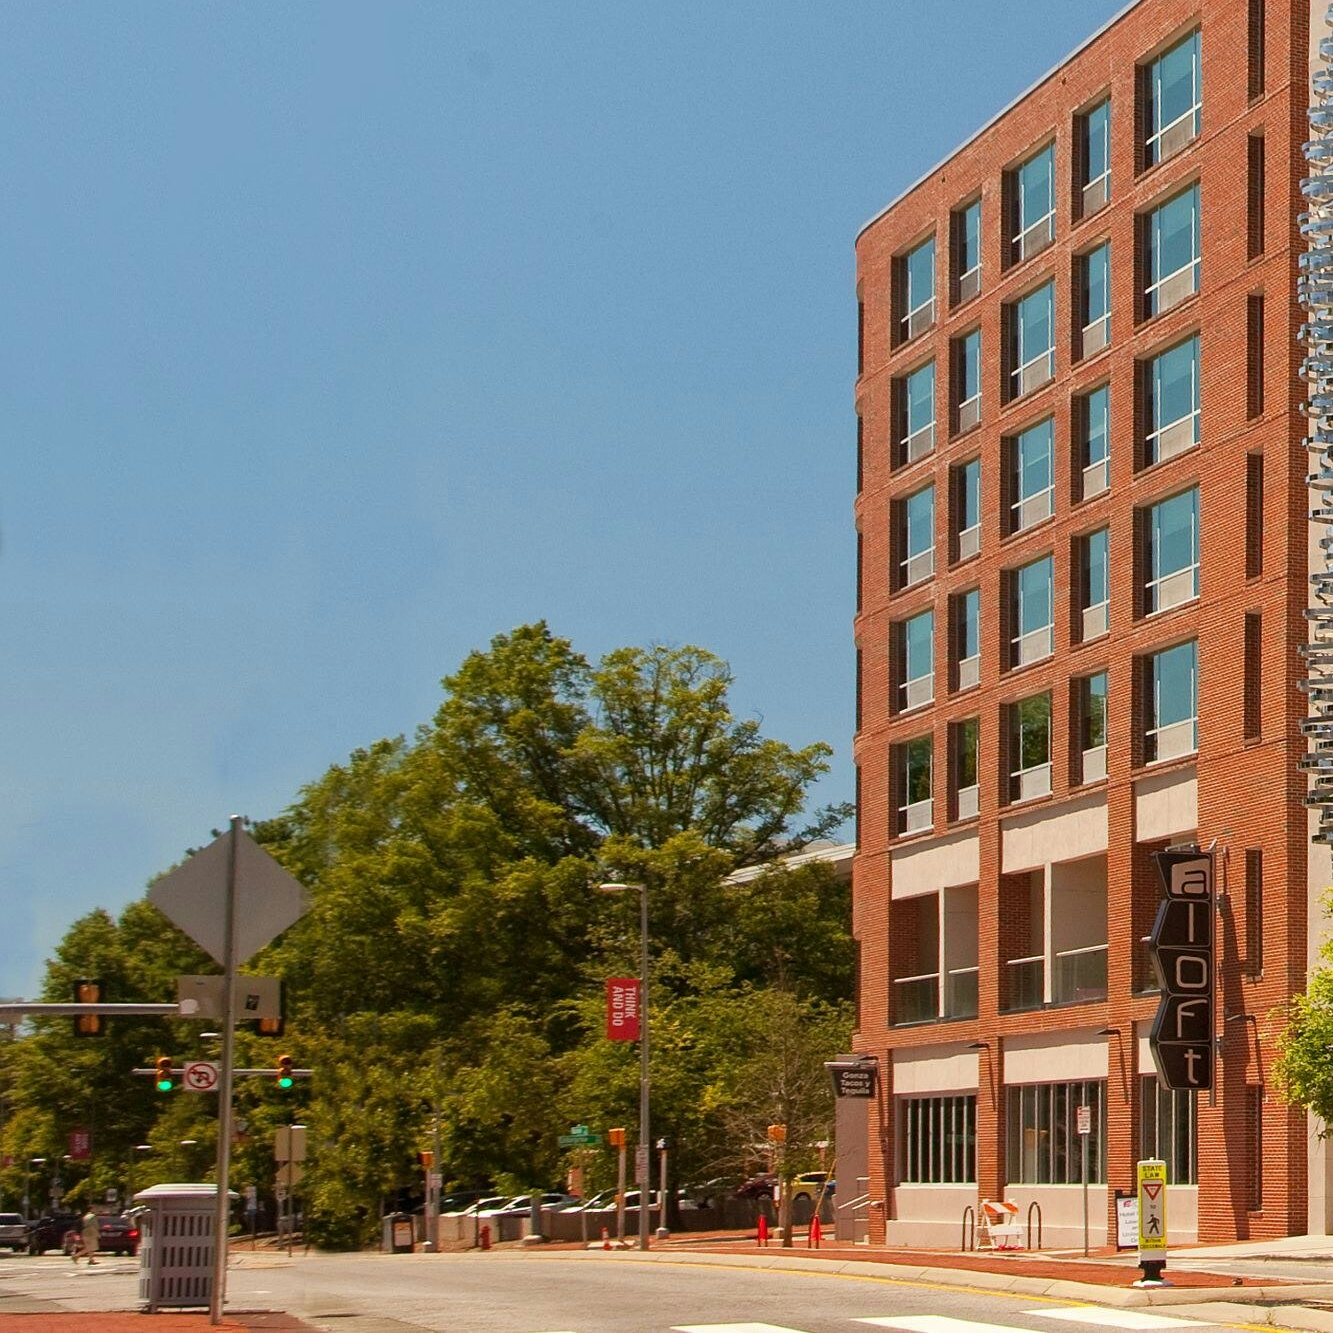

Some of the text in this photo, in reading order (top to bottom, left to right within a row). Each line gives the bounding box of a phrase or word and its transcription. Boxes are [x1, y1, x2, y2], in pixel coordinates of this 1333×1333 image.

[1171, 859, 1211, 1085] aloft
[612, 986, 624, 1026] AND DO
[625, 986, 636, 1018] THINK
